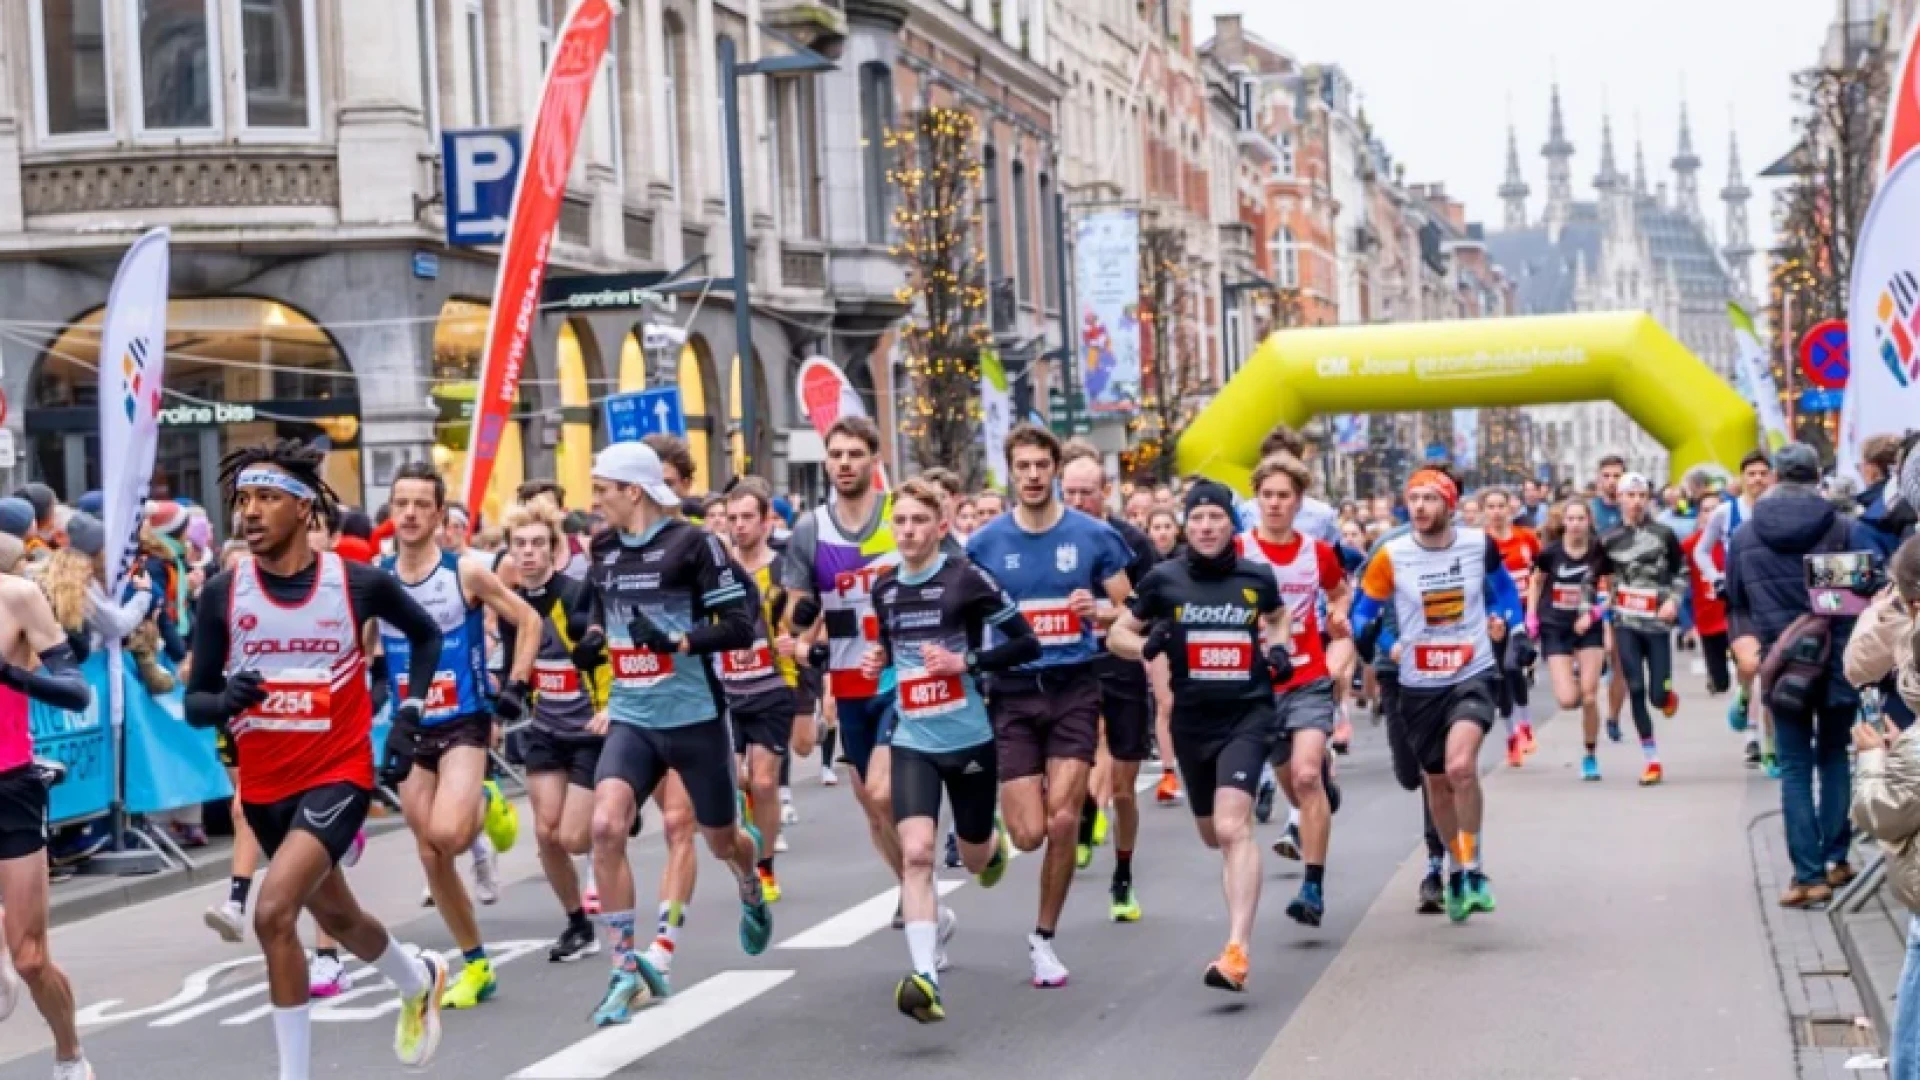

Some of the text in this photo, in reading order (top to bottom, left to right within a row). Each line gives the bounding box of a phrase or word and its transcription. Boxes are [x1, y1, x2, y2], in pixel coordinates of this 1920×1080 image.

[454, 136, 516, 214] P
[568, 289, 630, 307] caroline
[159, 404, 212, 425] roline
[835, 565, 894, 598] PT
[243, 638, 340, 655] GOLAZO
